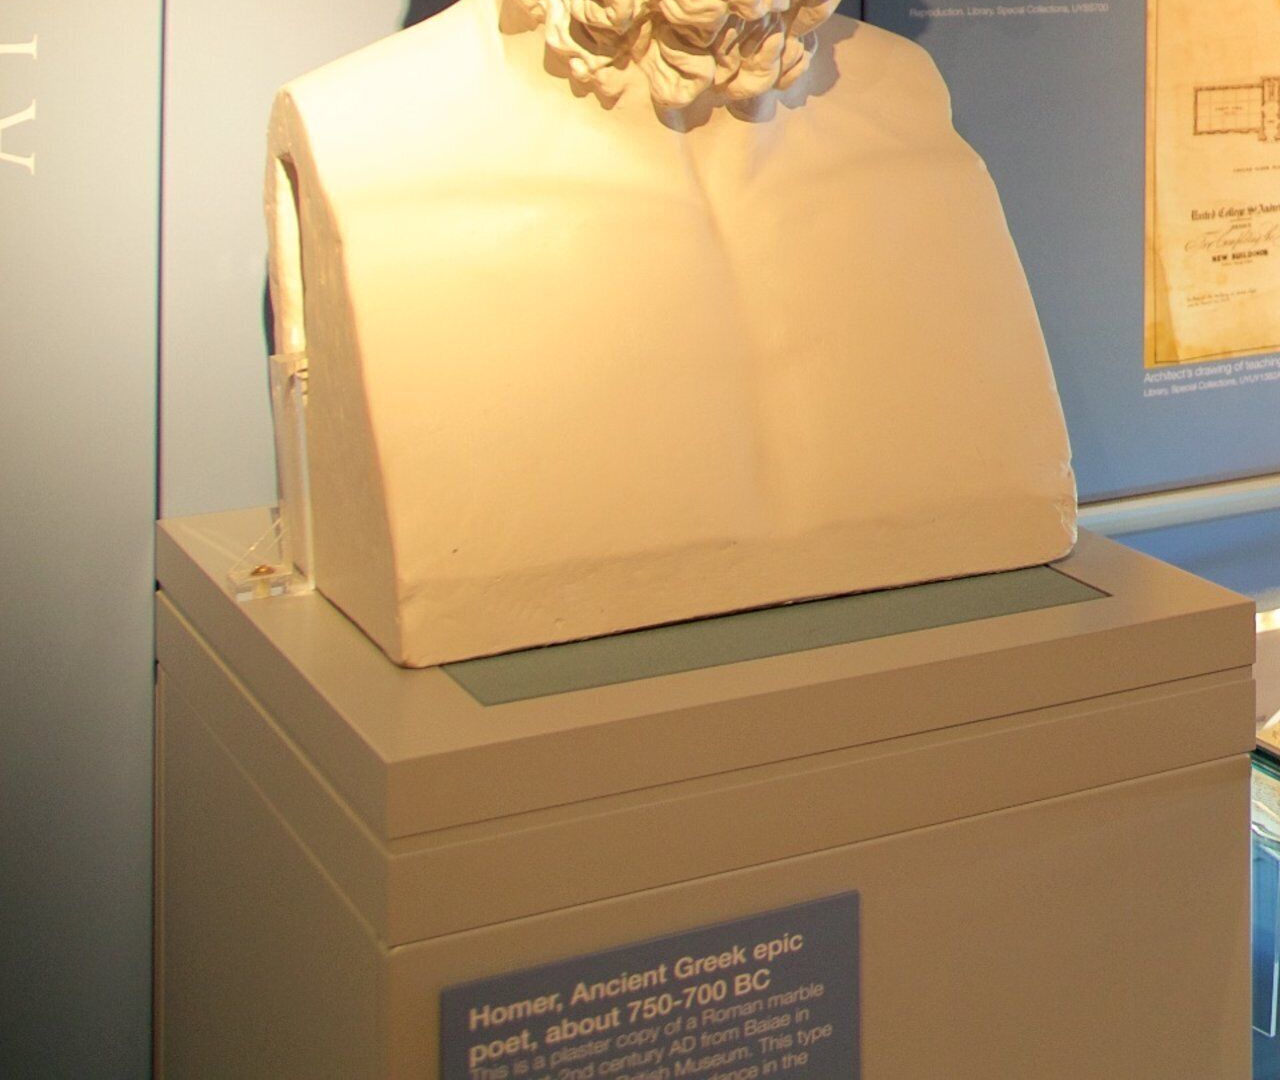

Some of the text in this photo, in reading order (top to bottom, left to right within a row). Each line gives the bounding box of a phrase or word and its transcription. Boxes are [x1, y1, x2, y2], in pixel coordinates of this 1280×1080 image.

[1195, 364, 1232, 377] drawing
[1234, 361, 1244, 373] of
[469, 933, 804, 1032] Homer, Ancient Greek epic
[469, 968, 772, 1069] poet, about 750-700 BC
[532, 1055, 546, 1071] a
[550, 1038, 610, 1068] plaster
[615, 1027, 661, 1049] copy
[664, 1017, 682, 1036] of
[686, 1016, 697, 1030] a
[702, 999, 763, 1025] Roman
[767, 983, 825, 1008] marble
[669, 1035, 697, 1056] AD
[701, 1027, 740, 1048] from
[795, 1007, 810, 1024] in
[758, 1033, 793, 1054] This
[797, 1023, 833, 1046] type
[762, 1051, 809, 1074] in the
